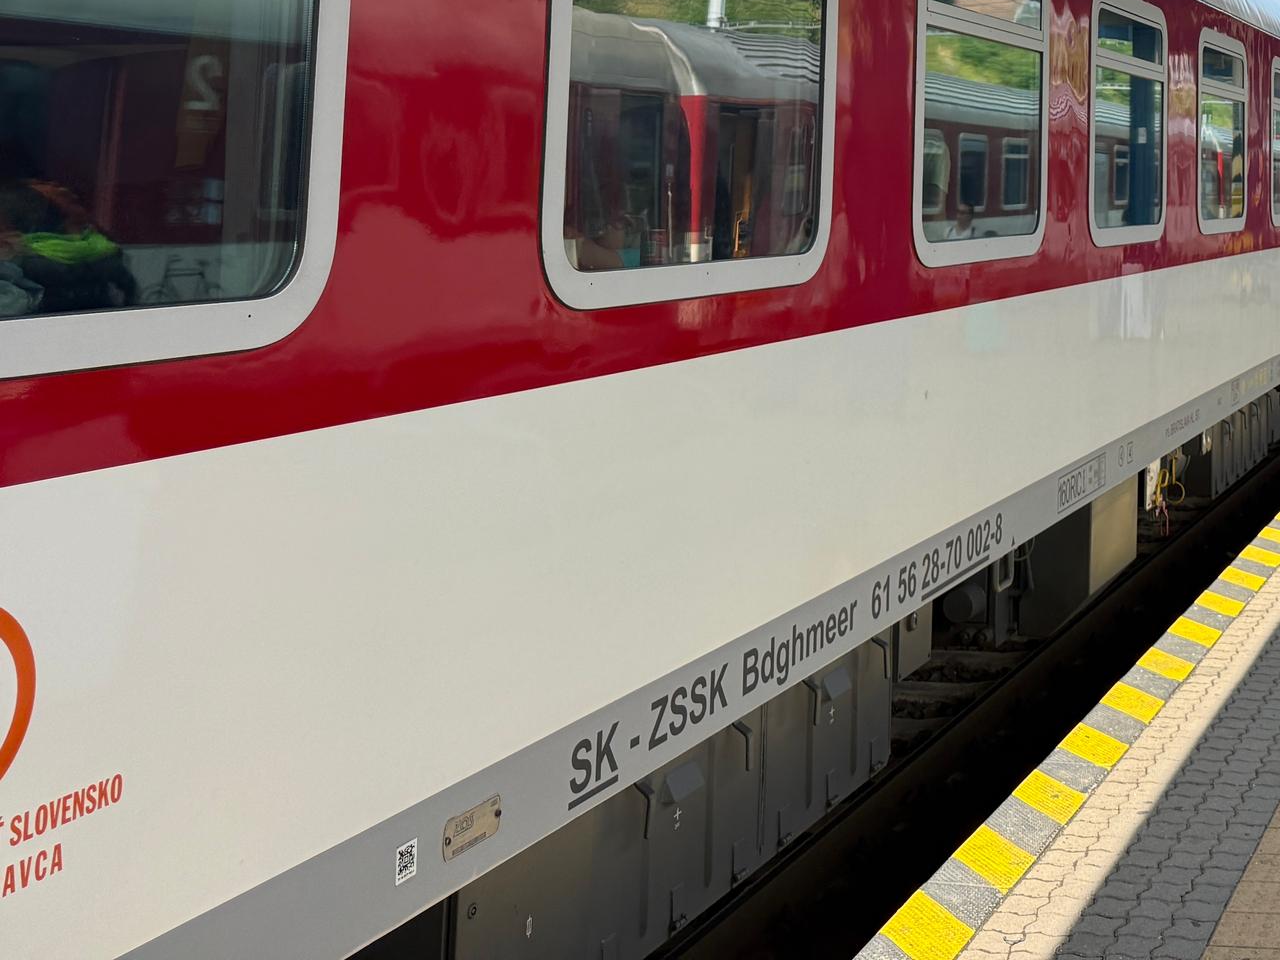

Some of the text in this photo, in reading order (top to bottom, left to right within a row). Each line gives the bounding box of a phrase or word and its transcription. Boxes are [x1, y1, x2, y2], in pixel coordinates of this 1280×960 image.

[569, 721, 620, 794] SK
[648, 662, 729, 751] ZSSK
[743, 599, 857, 696] Bdghmeer
[871, 575, 890, 620] 61
[898, 561, 917, 604] 56
[921, 535, 962, 590] 28-70
[966, 512, 1003, 562] 002-8
[9, 773, 123, 847] SLOVENSKO
